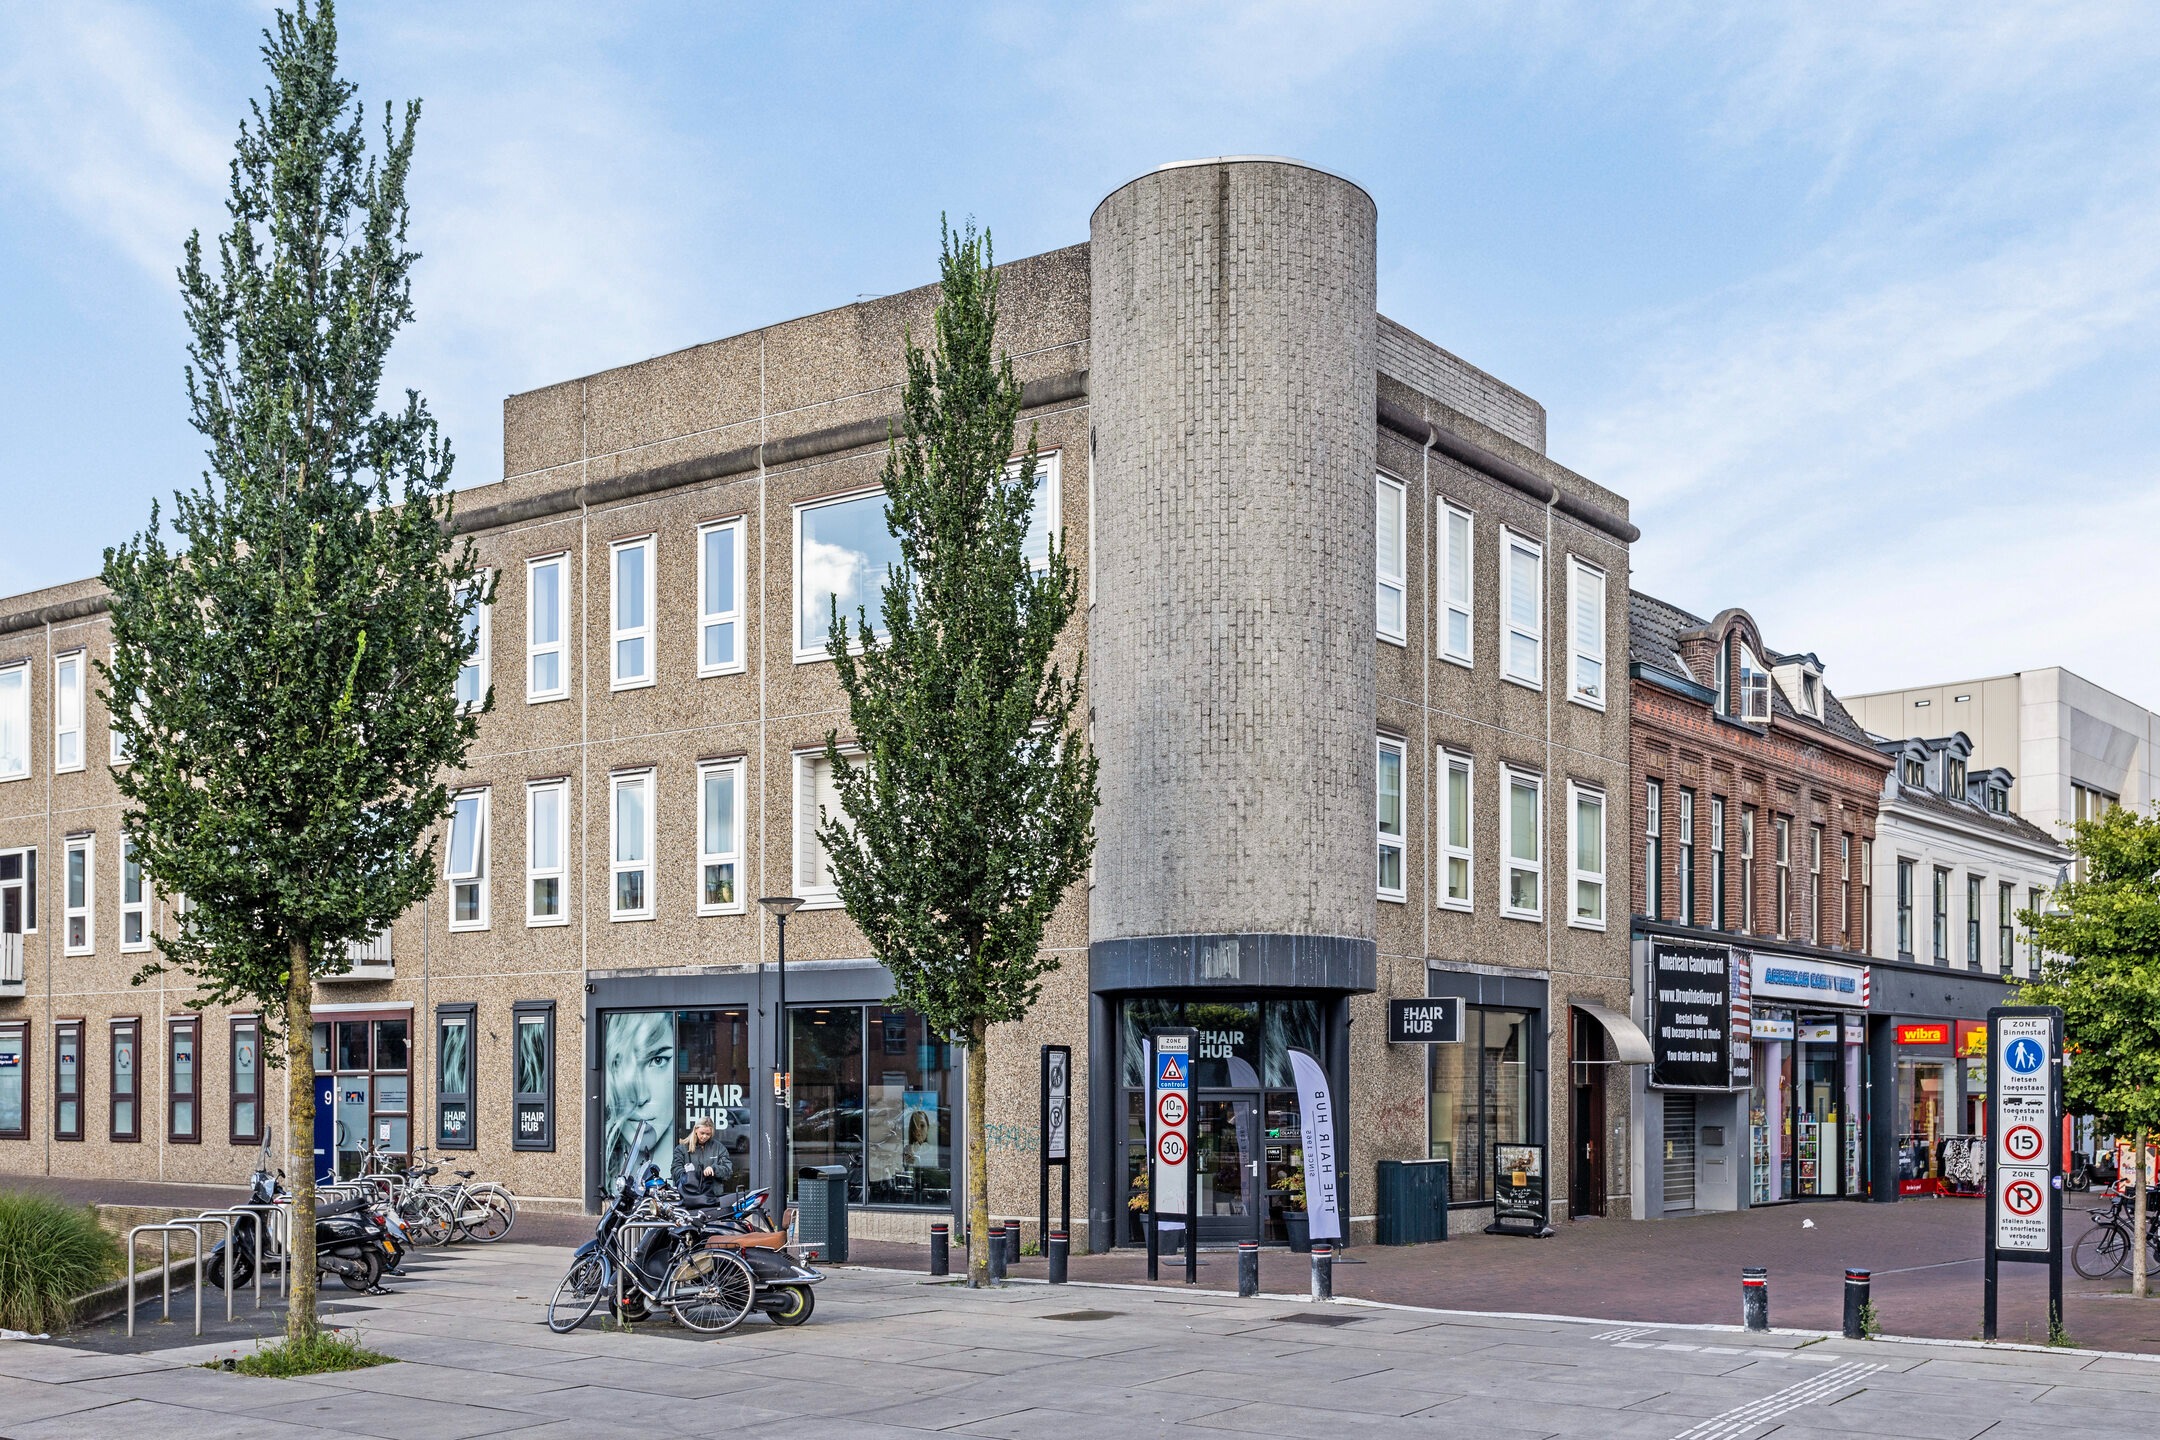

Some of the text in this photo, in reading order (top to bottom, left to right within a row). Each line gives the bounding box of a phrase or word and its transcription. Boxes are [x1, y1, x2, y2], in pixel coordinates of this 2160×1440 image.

[1660, 953, 1688, 971] American
[1410, 1007, 1443, 1019] HAIR
[1676, 1013, 1708, 1025] Bestel Online
[1404, 1020, 1433, 1033] HUB
[1206, 1030, 1244, 1045] HAIR
[1904, 1028, 1940, 1040] wibra
[1200, 1045, 1233, 1058] HUB
[324, 1091, 332, 1105] 9
[694, 1085, 743, 1106] HAIR
[448, 1111, 466, 1120] HAIR
[525, 1112, 544, 1122] HAIR
[444, 1121, 461, 1130] HUB
[521, 1122, 539, 1131] HUB
[2014, 1136, 2034, 1150] 15
